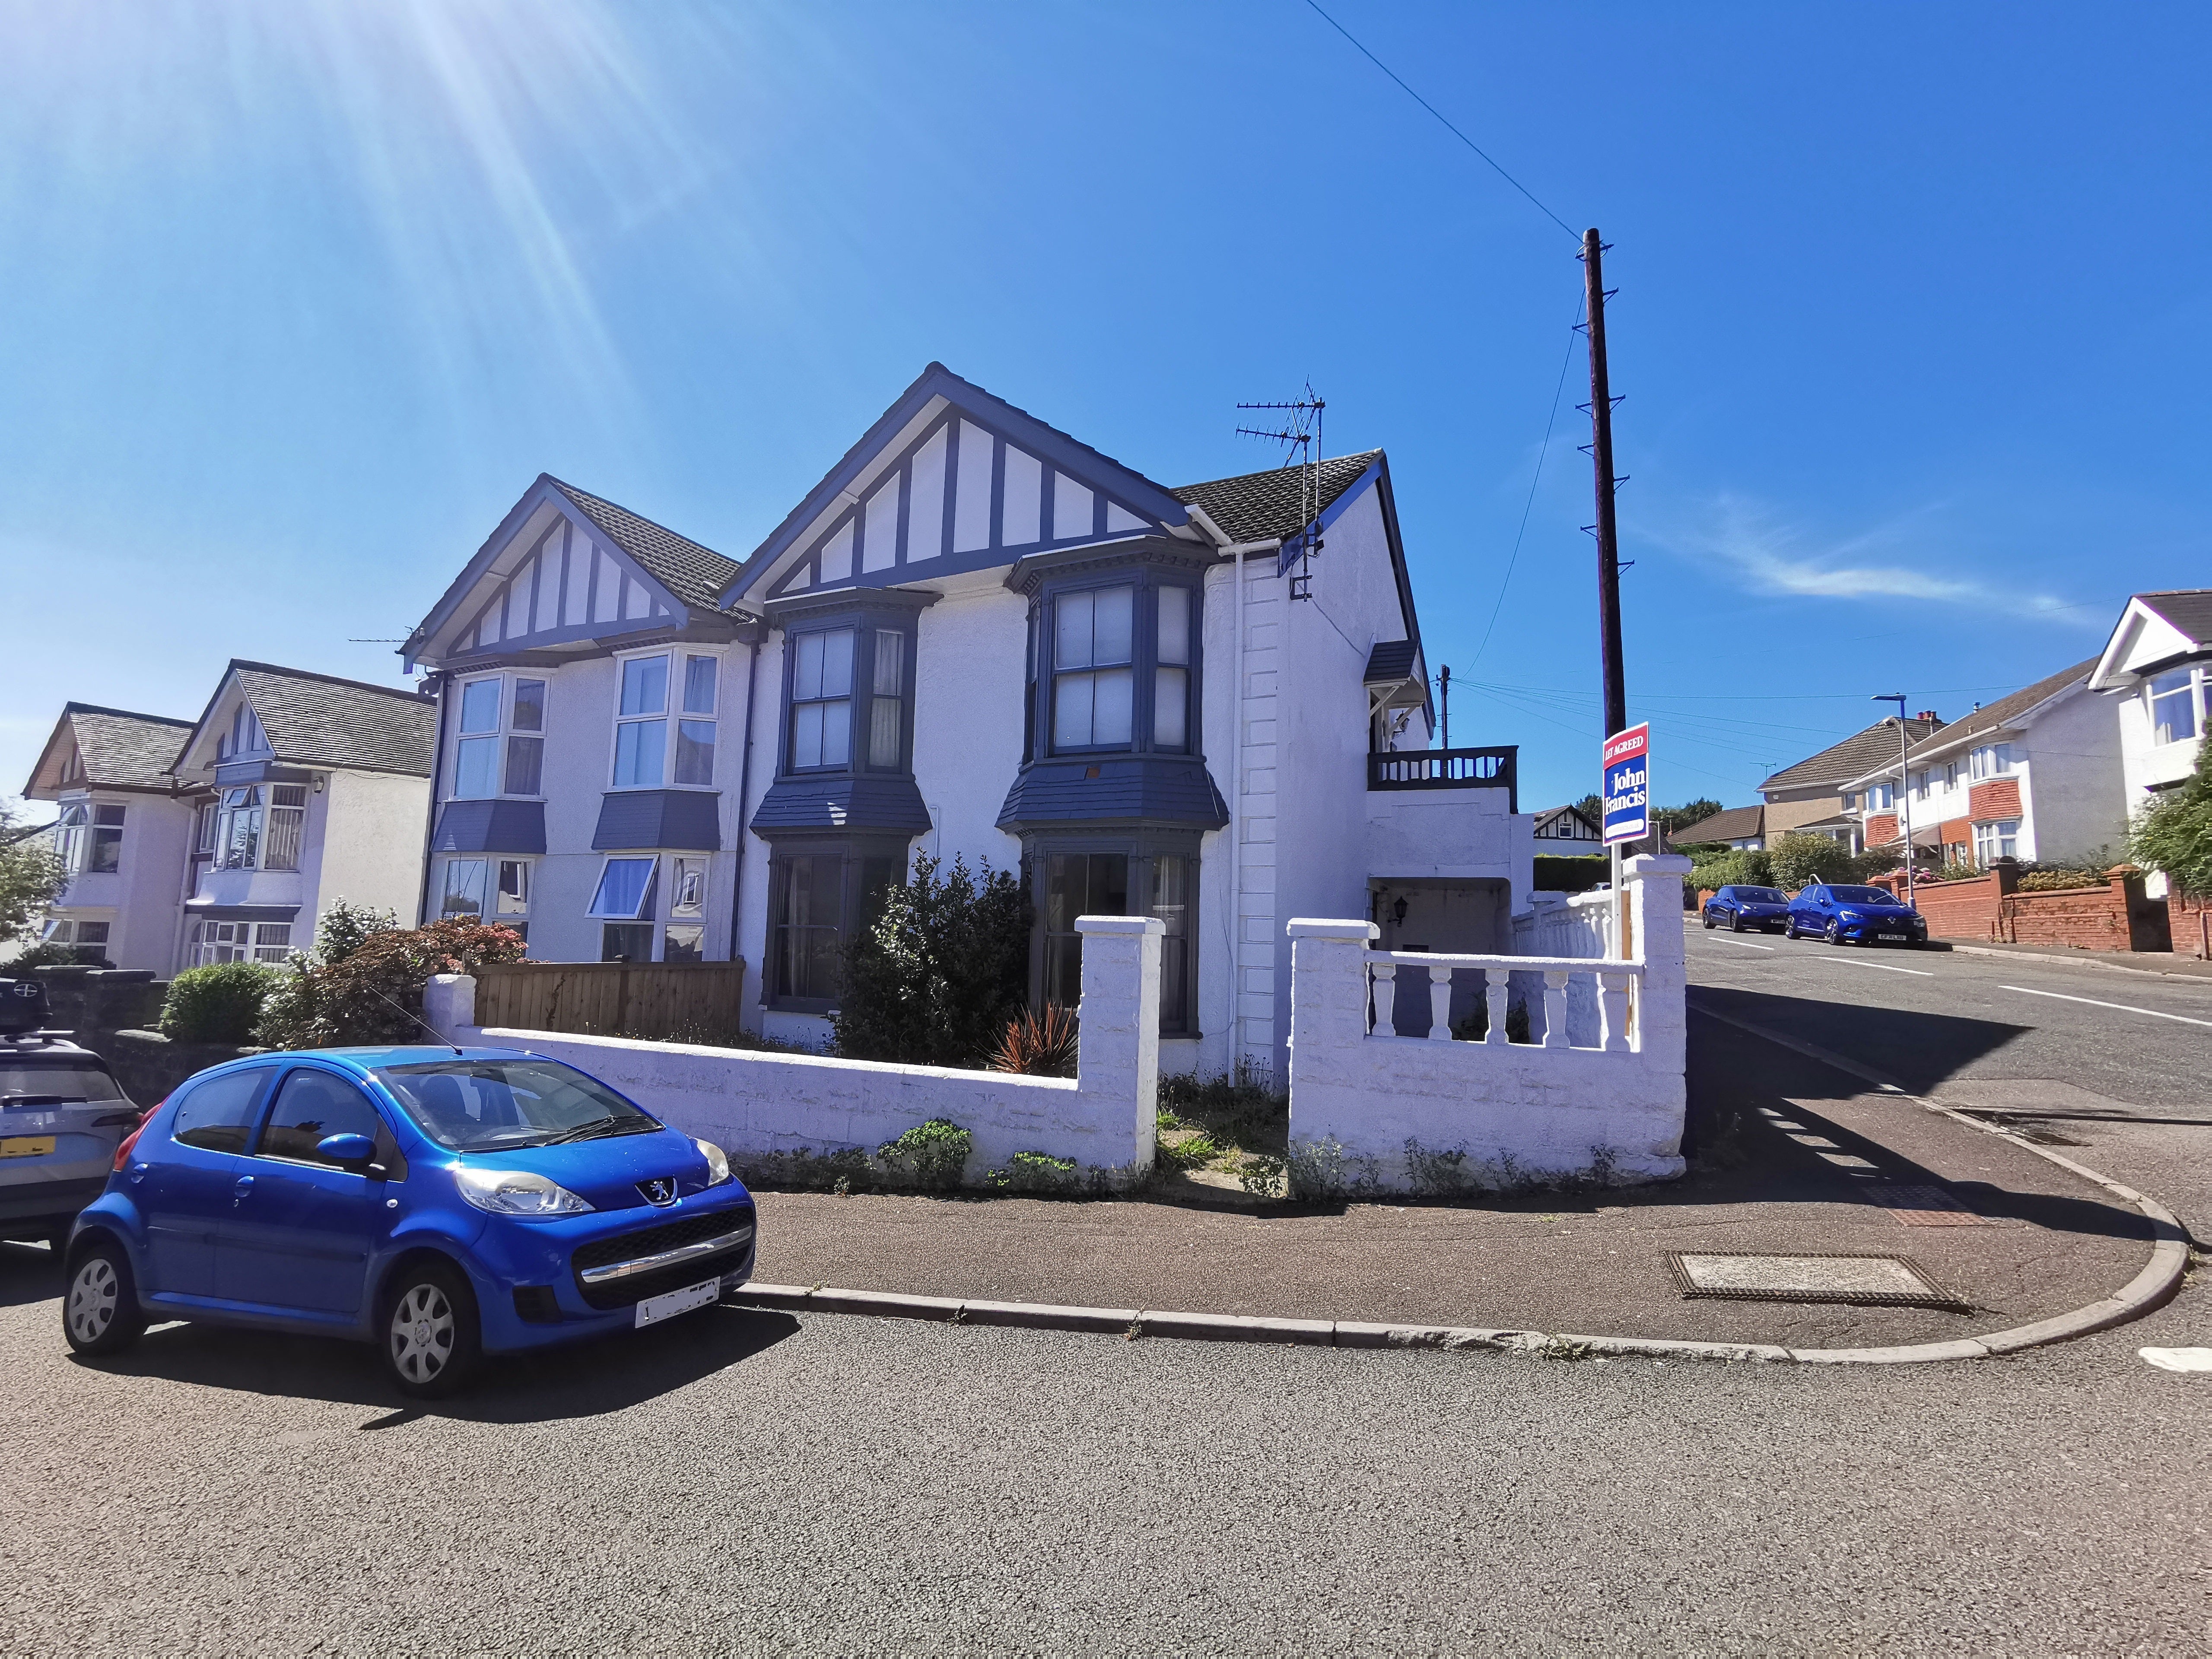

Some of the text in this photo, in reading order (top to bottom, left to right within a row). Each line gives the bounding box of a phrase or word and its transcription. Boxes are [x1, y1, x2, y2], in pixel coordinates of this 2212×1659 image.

[1605, 736, 1643, 761] LET AGREED
[1614, 768, 1645, 796] John
[1605, 786, 1645, 815] Francis
